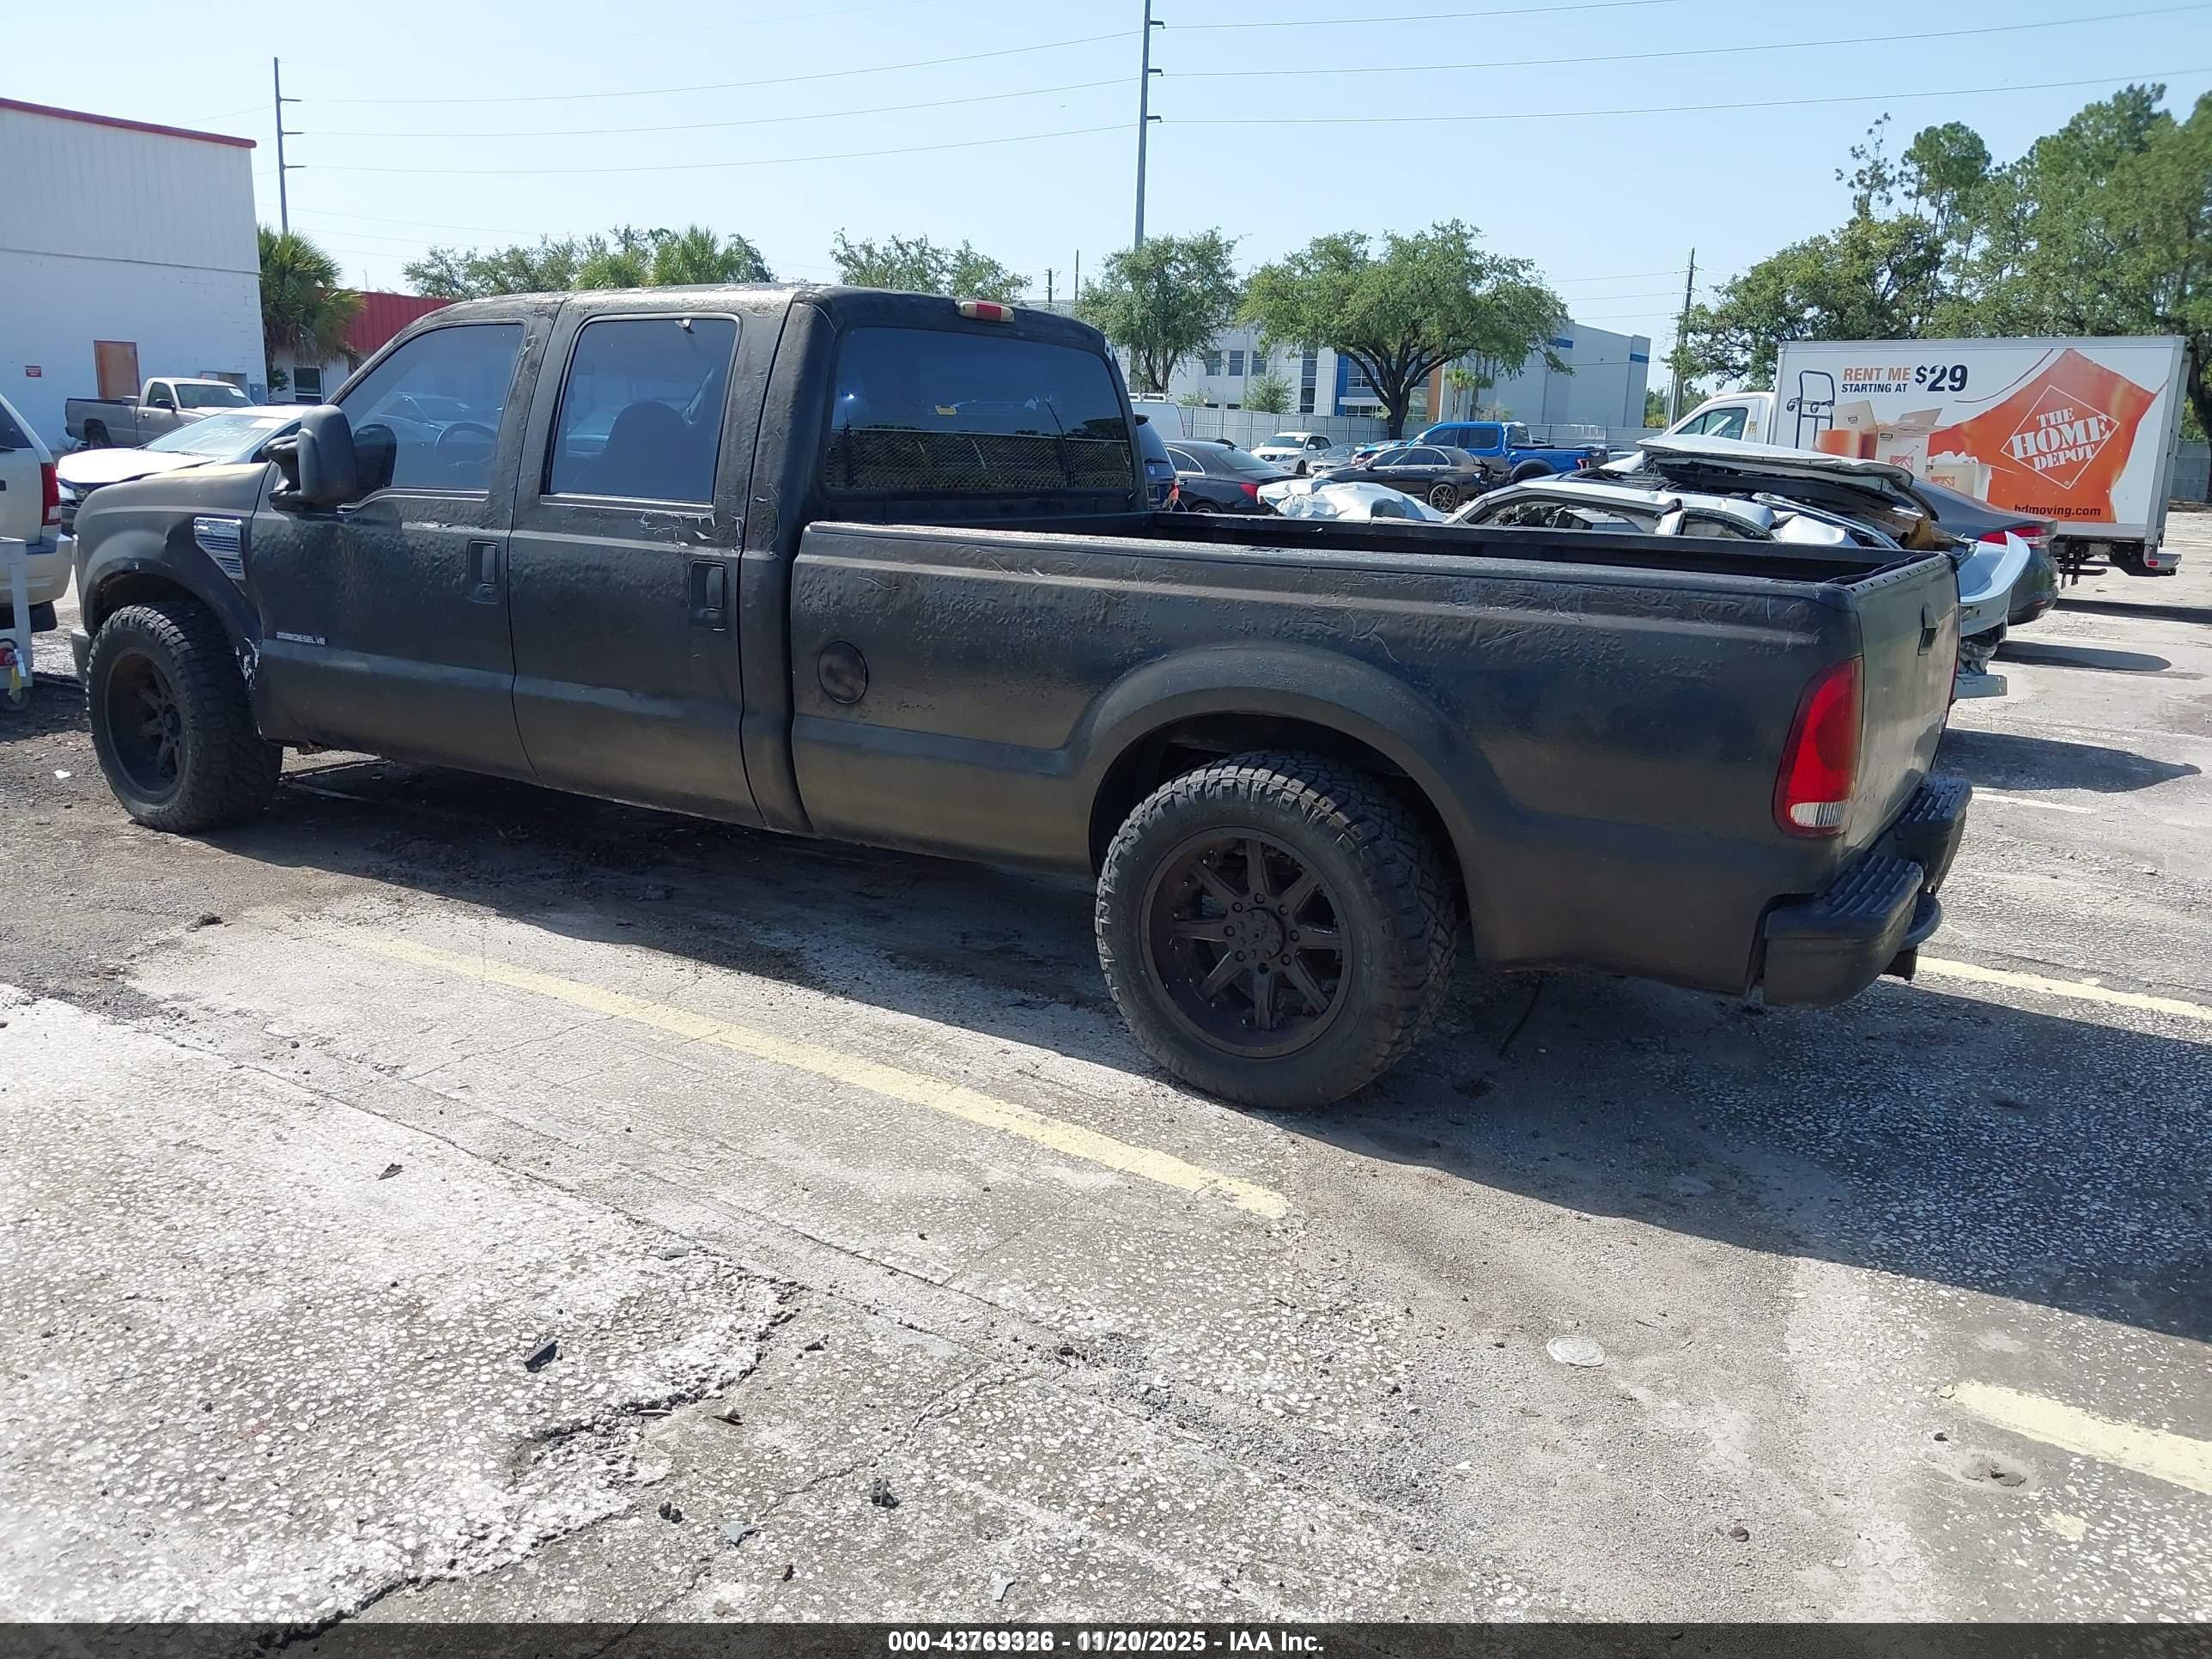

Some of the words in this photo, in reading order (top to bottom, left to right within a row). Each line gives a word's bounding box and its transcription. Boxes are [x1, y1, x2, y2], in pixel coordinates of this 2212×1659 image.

[1843, 368, 1884, 381] RENT
[1887, 367, 1911, 381] ME
[1914, 364, 1968, 392] $29
[1841, 383, 1892, 393] STARTING
[1894, 383, 1908, 393] AT
[2036, 407, 2075, 428] THE
[2011, 414, 2111, 459] HOME
[2033, 444, 2095, 471] DEPOT
[2014, 504, 2101, 517] hdmoving.com
